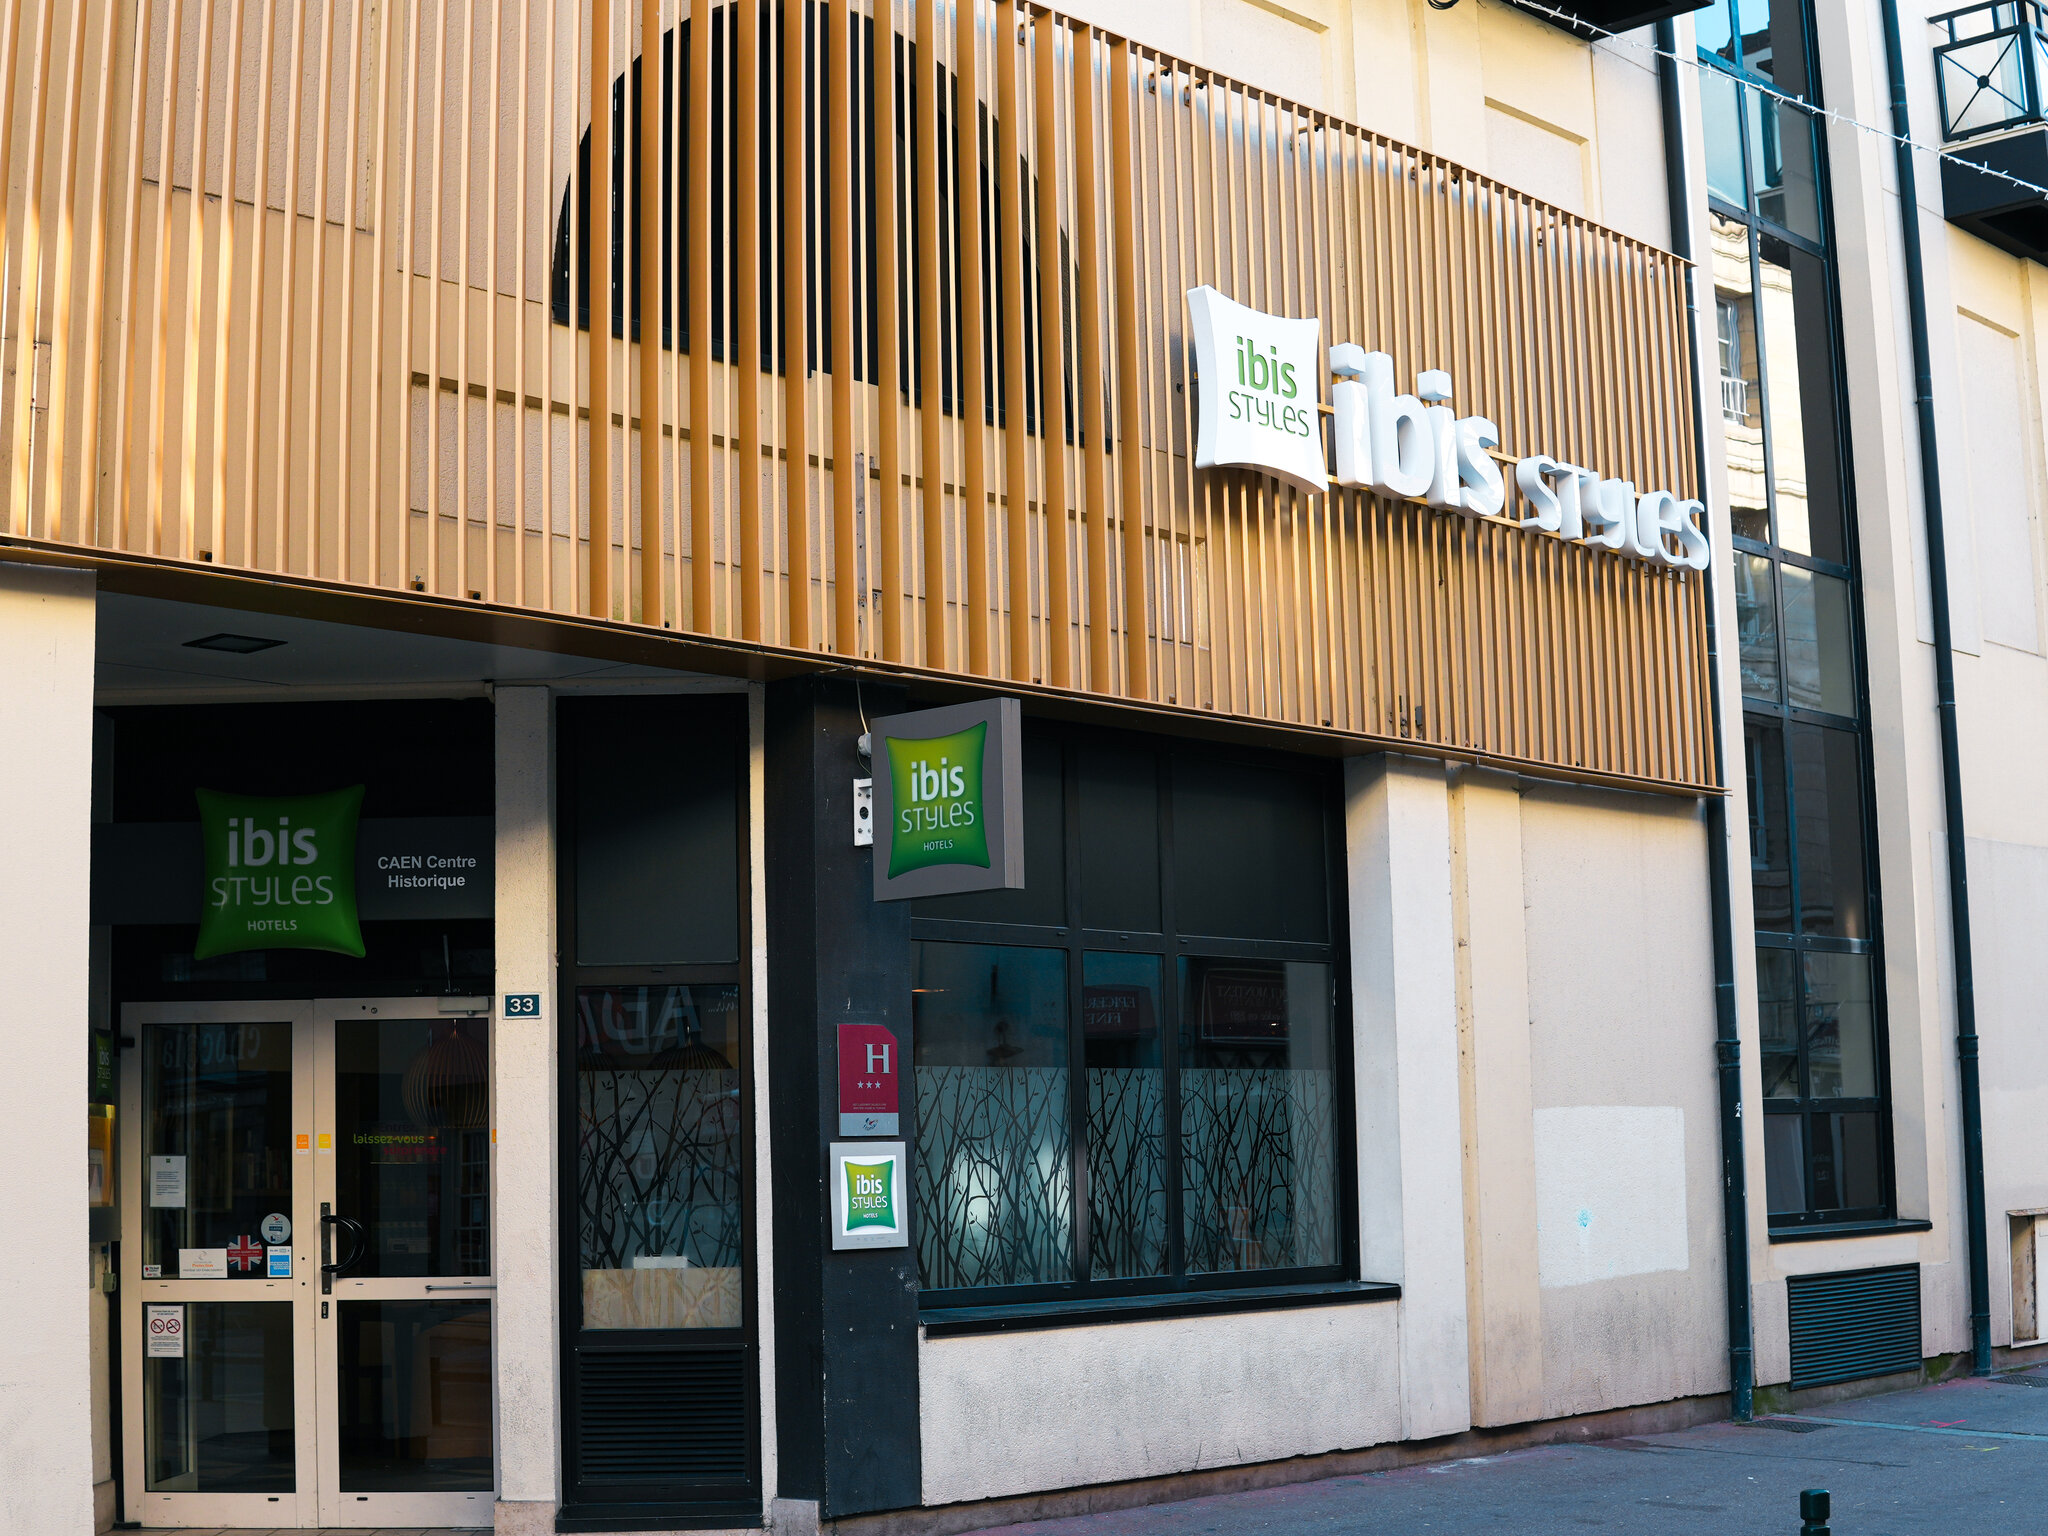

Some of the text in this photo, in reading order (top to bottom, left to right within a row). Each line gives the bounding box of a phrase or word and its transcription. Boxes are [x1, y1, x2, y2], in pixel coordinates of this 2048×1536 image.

[1235, 335, 1298, 400] ibis
[1330, 341, 1505, 519] ibis
[911, 757, 965, 803] ibis
[228, 816, 318, 867] ibis
[923, 838, 954, 852] HOTELS
[378, 854, 477, 870] CAEN Centre
[388, 872, 466, 890] Historique
[247, 919, 298, 931] HOTELS
[509, 998, 534, 1013] 33
[864, 1043, 892, 1074] H
[353, 1133, 425, 1145] laissez-vous
[856, 1174, 883, 1195] ibis
